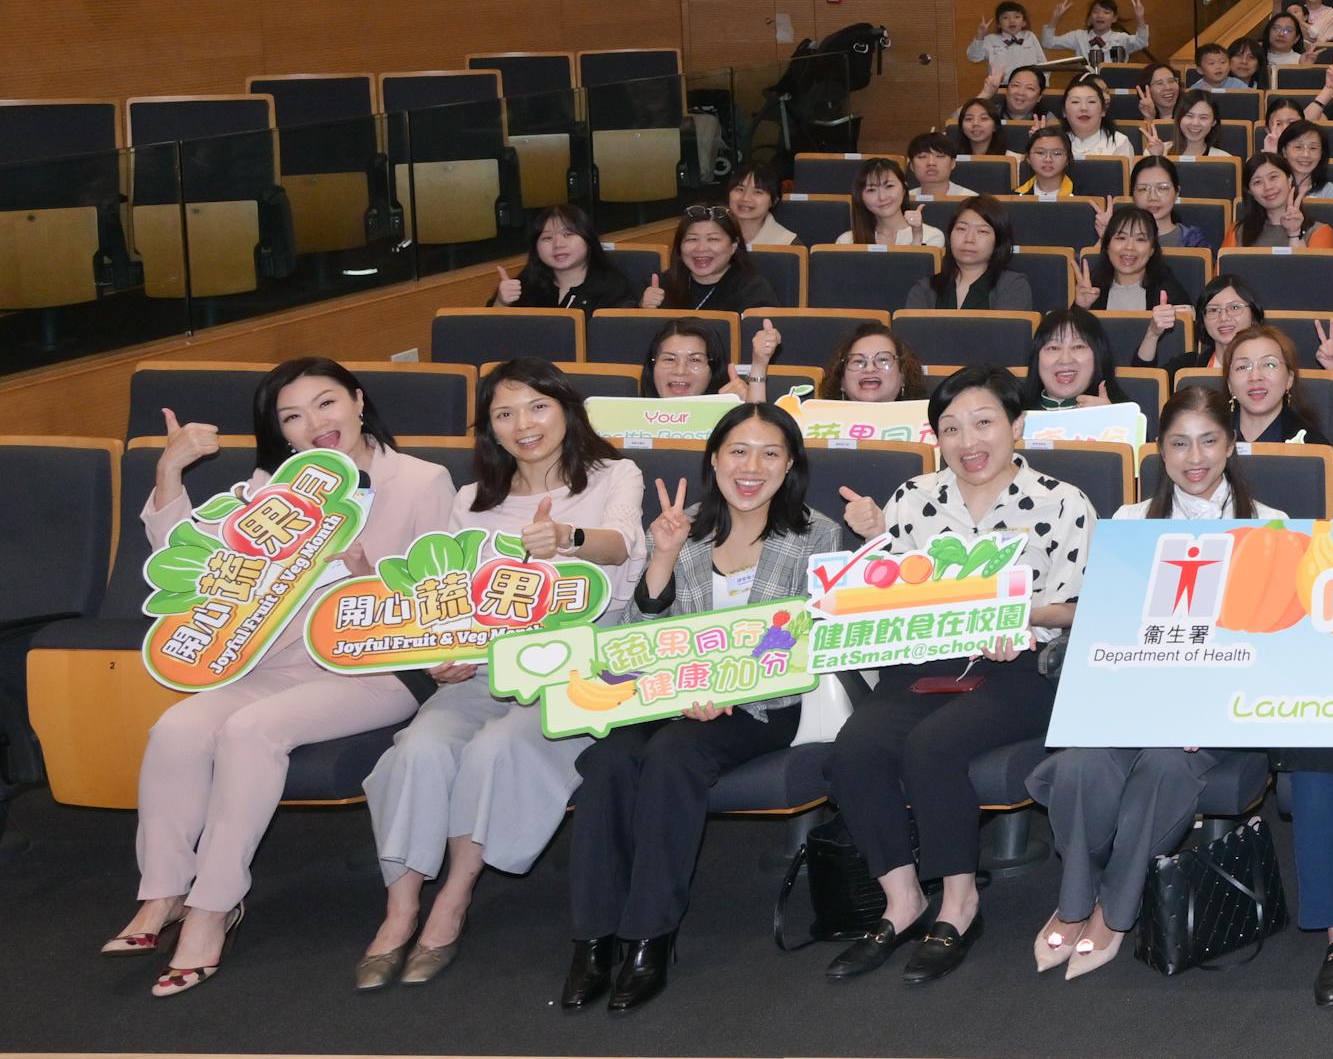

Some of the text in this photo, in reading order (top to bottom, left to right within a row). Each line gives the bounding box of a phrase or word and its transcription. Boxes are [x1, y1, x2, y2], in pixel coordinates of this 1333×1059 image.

[645, 412, 689, 423] Your
[161, 465, 340, 663] 開心蔬果月
[209, 514, 344, 675] Joyful Fruit & Veg Month
[337, 568, 588, 626] 開心蔬果月
[333, 638, 391, 657] Joyful
[390, 632, 437, 652] Fruit
[439, 632, 454, 646] &
[457, 629, 488, 647] Veg
[606, 620, 766, 672] 蔬果同行
[812, 632, 1026, 670] EatSmart@schoolk
[813, 602, 1028, 652] 健康飲食在校園
[109, 662, 116, 670] 2
[639, 652, 788, 703] 健康加分
[1093, 648, 1251, 663] Department of Health
